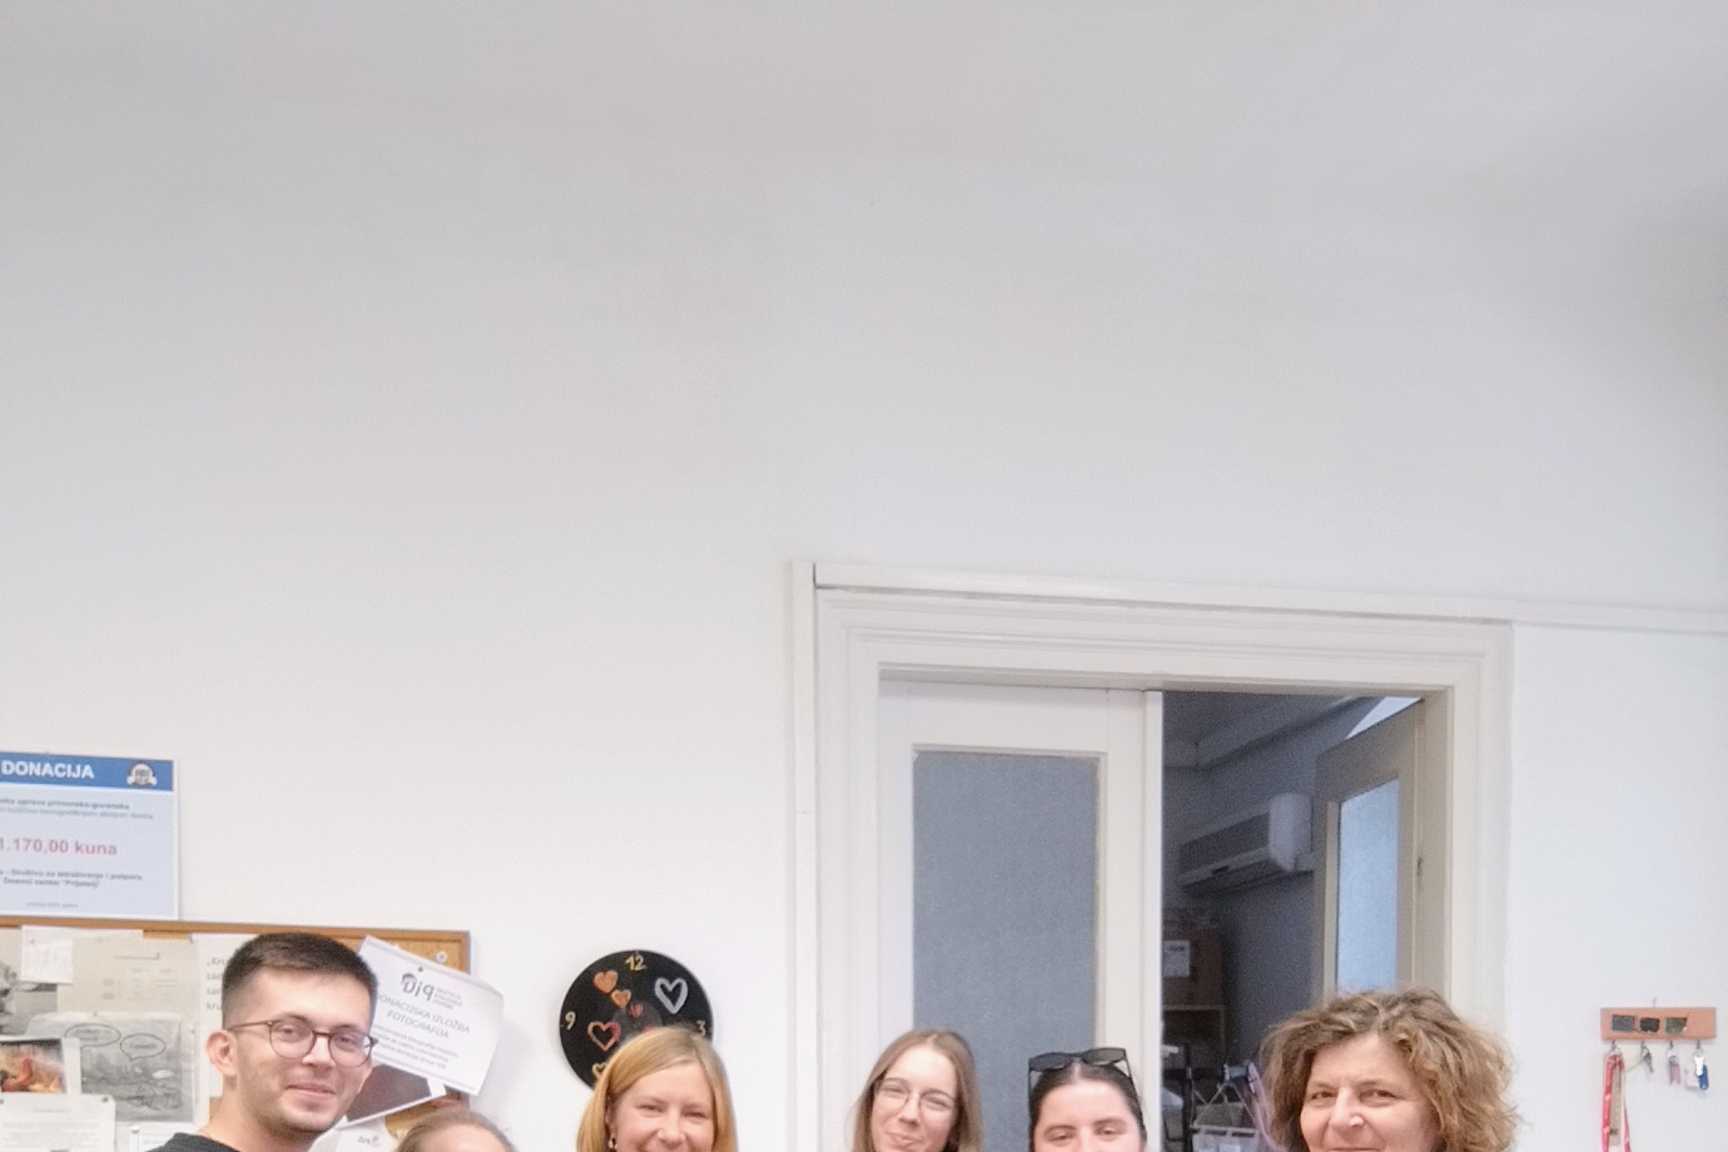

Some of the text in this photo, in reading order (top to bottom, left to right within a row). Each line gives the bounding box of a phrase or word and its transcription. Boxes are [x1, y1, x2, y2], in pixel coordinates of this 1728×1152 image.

[1, 760, 95, 779] DONACIJA
[74, 840, 118, 856] kuna
[626, 955, 647, 971] 12
[564, 1011, 577, 1031] 9
